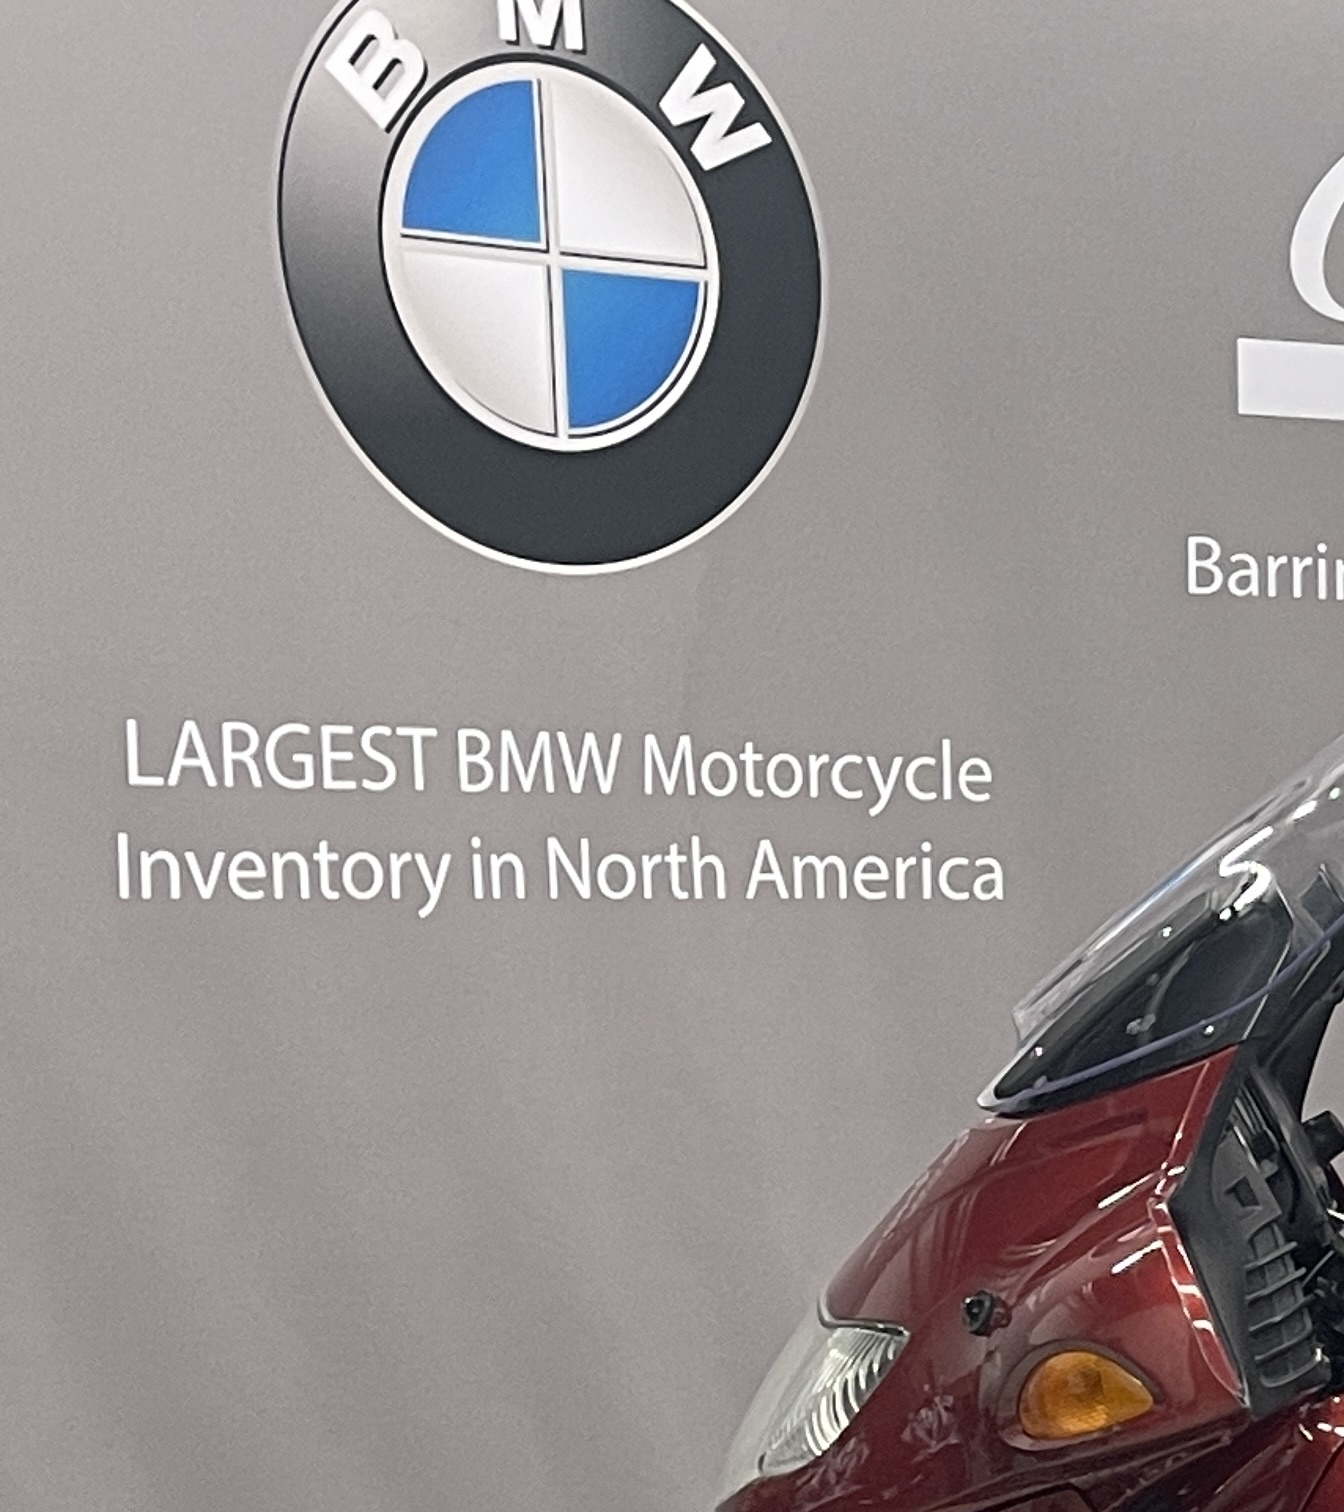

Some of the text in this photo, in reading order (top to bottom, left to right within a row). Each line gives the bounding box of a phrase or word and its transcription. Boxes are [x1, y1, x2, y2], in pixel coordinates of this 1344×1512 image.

[324, 0, 773, 172] BMW
[125, 718, 994, 816] LARGEST BMW Motorcycle
[117, 832, 1006, 920] Inventory in North America
